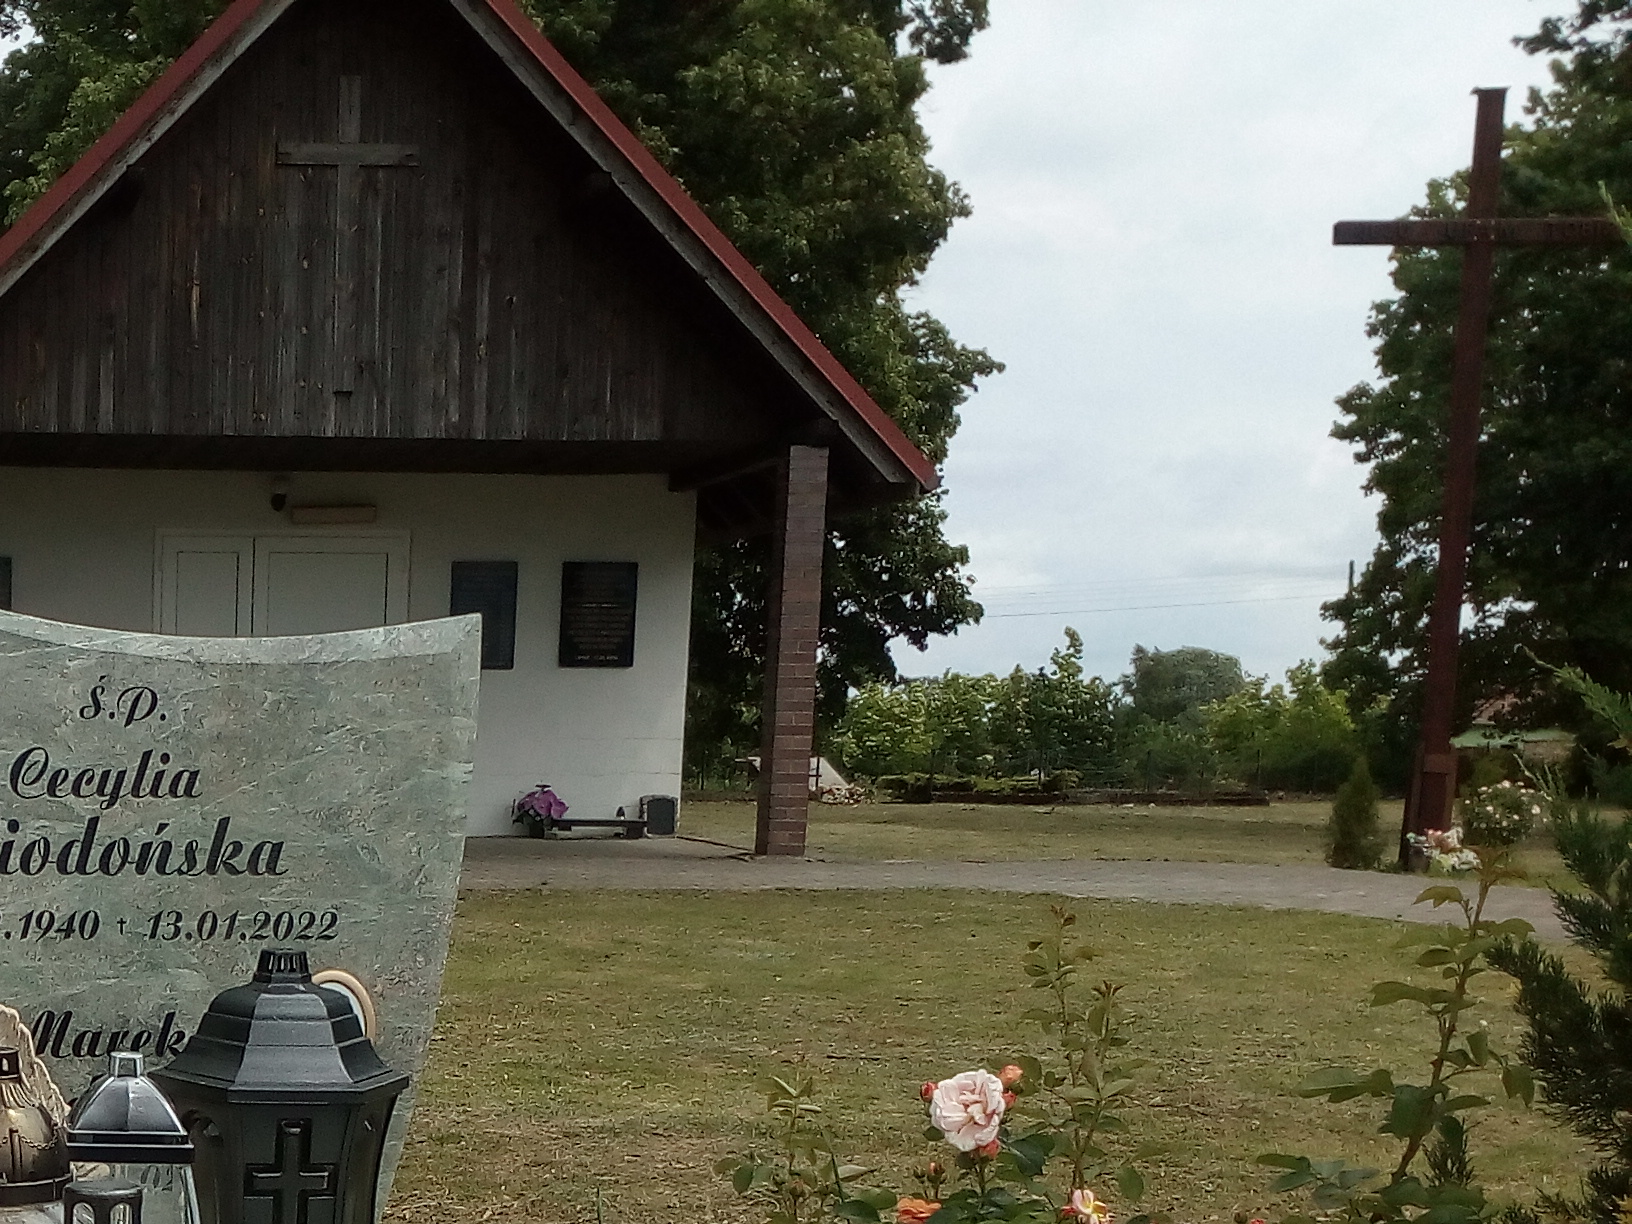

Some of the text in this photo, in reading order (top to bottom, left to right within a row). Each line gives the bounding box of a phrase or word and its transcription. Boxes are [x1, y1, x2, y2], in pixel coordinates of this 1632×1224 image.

[8, 746, 204, 811] Cecylia
[147, 908, 340, 943] 13.01.2022
[31, 1009, 186, 1059] Marek
